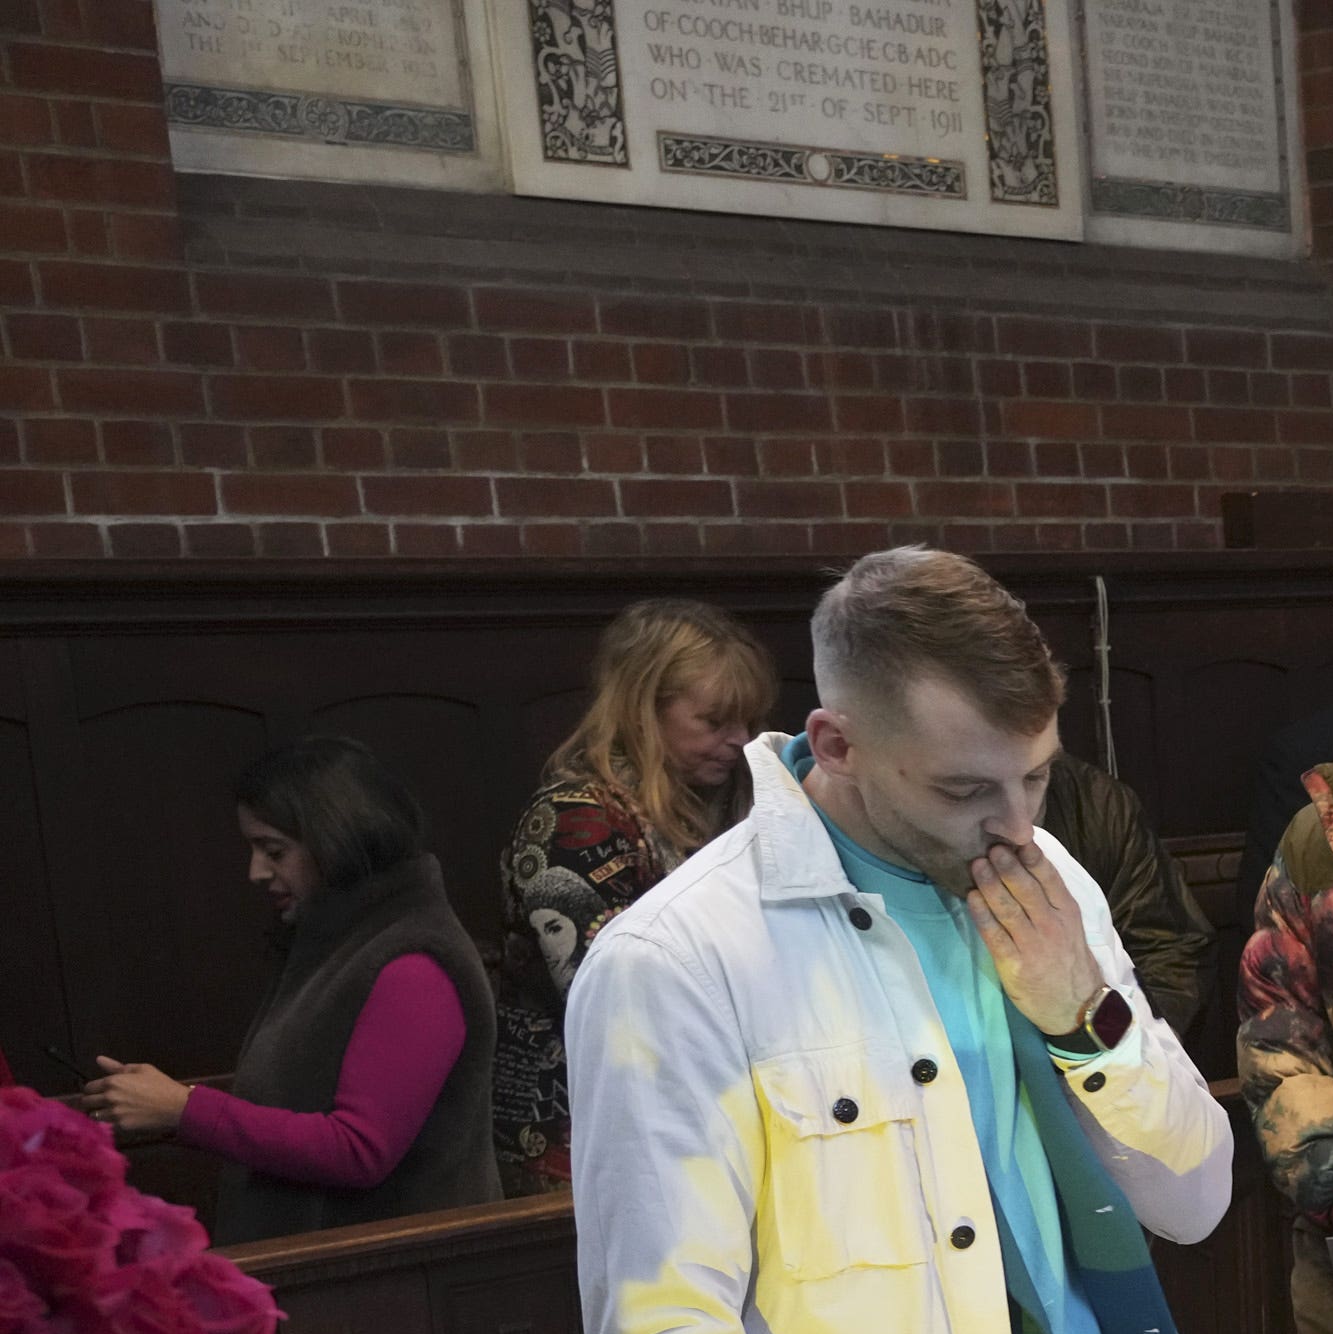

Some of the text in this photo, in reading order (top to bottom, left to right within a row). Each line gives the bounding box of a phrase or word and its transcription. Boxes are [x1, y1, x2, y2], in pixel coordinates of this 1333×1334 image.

[644, 9, 671, 31] OF
[678, 14, 754, 43] COOCH
[759, 25, 822, 53] BEHAR
[850, 6, 947, 38] BAHADUR
[647, 43, 961, 102] WHO WAS CREMATED HERE
[650, 78, 687, 102] ON
[704, 83, 752, 110] THE
[821, 97, 848, 119] OF
[863, 103, 917, 127] SEPT
[931, 109, 963, 138] 1911
